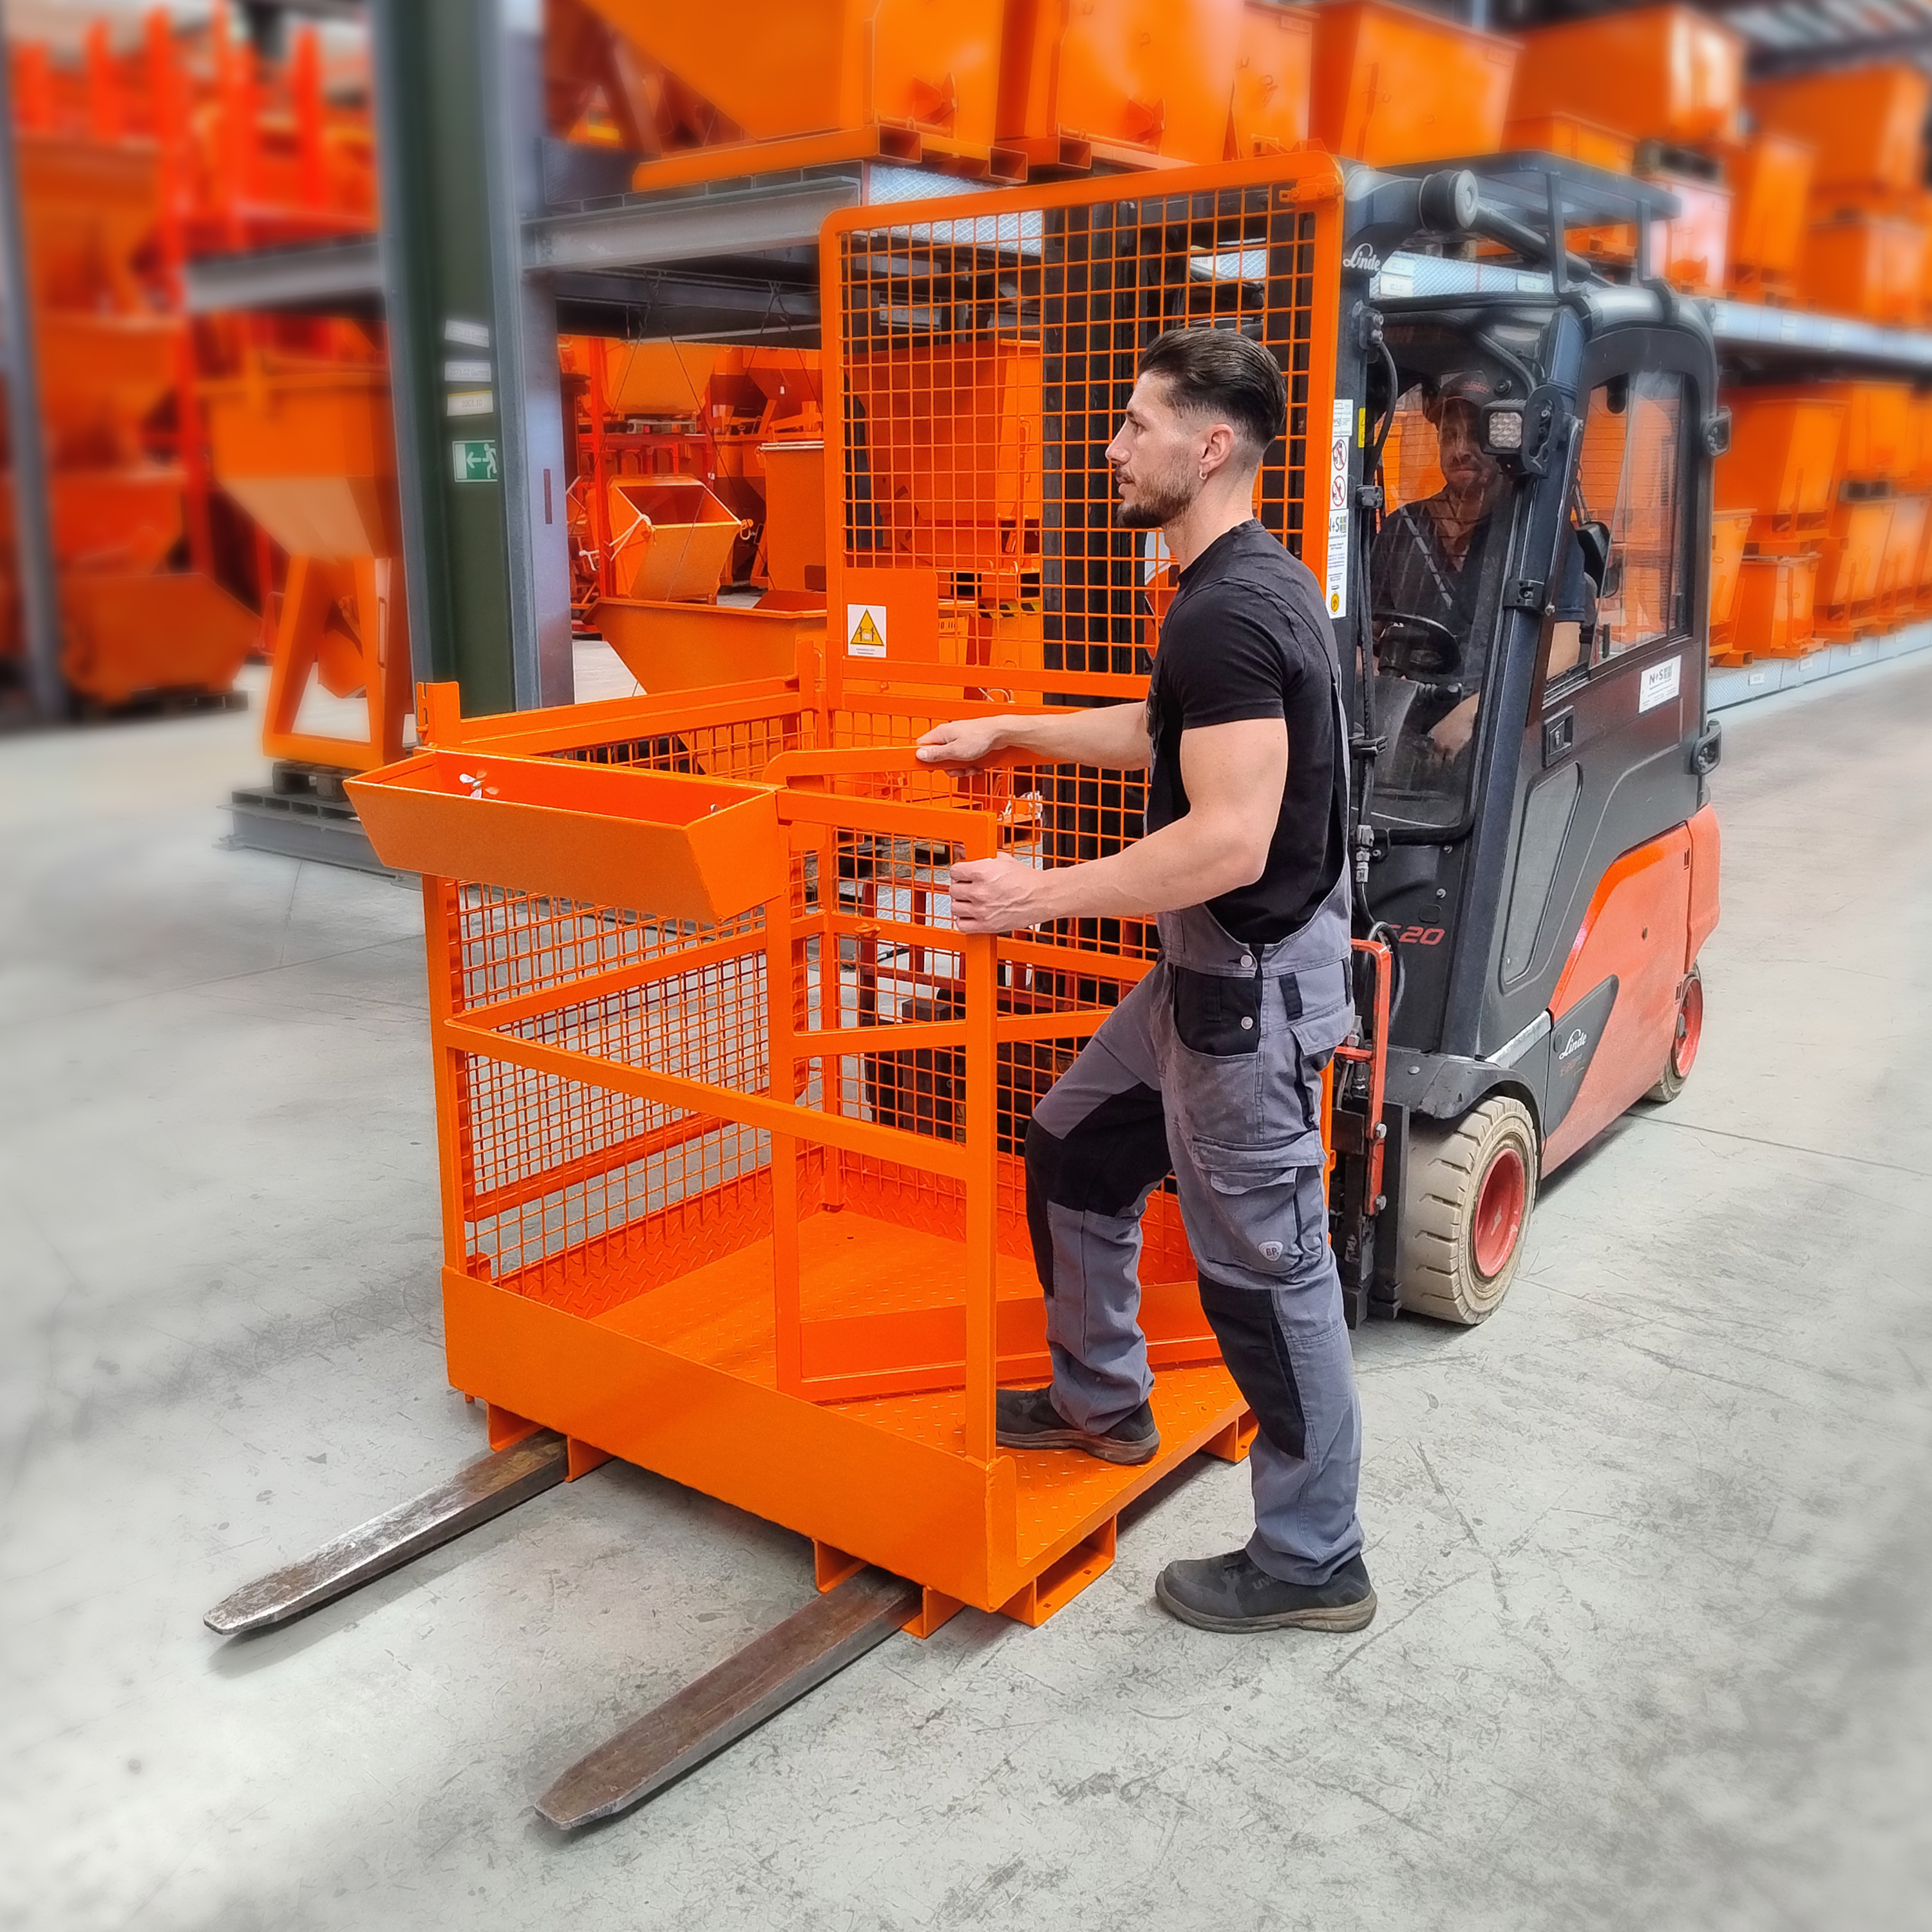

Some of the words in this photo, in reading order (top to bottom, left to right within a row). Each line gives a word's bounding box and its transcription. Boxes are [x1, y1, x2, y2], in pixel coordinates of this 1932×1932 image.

[1343, 243, 1380, 271] Linde
[1649, 668, 1663, 685] N+S
[1389, 924, 1446, 945] 20
[1558, 1028, 1587, 1060] Linde
